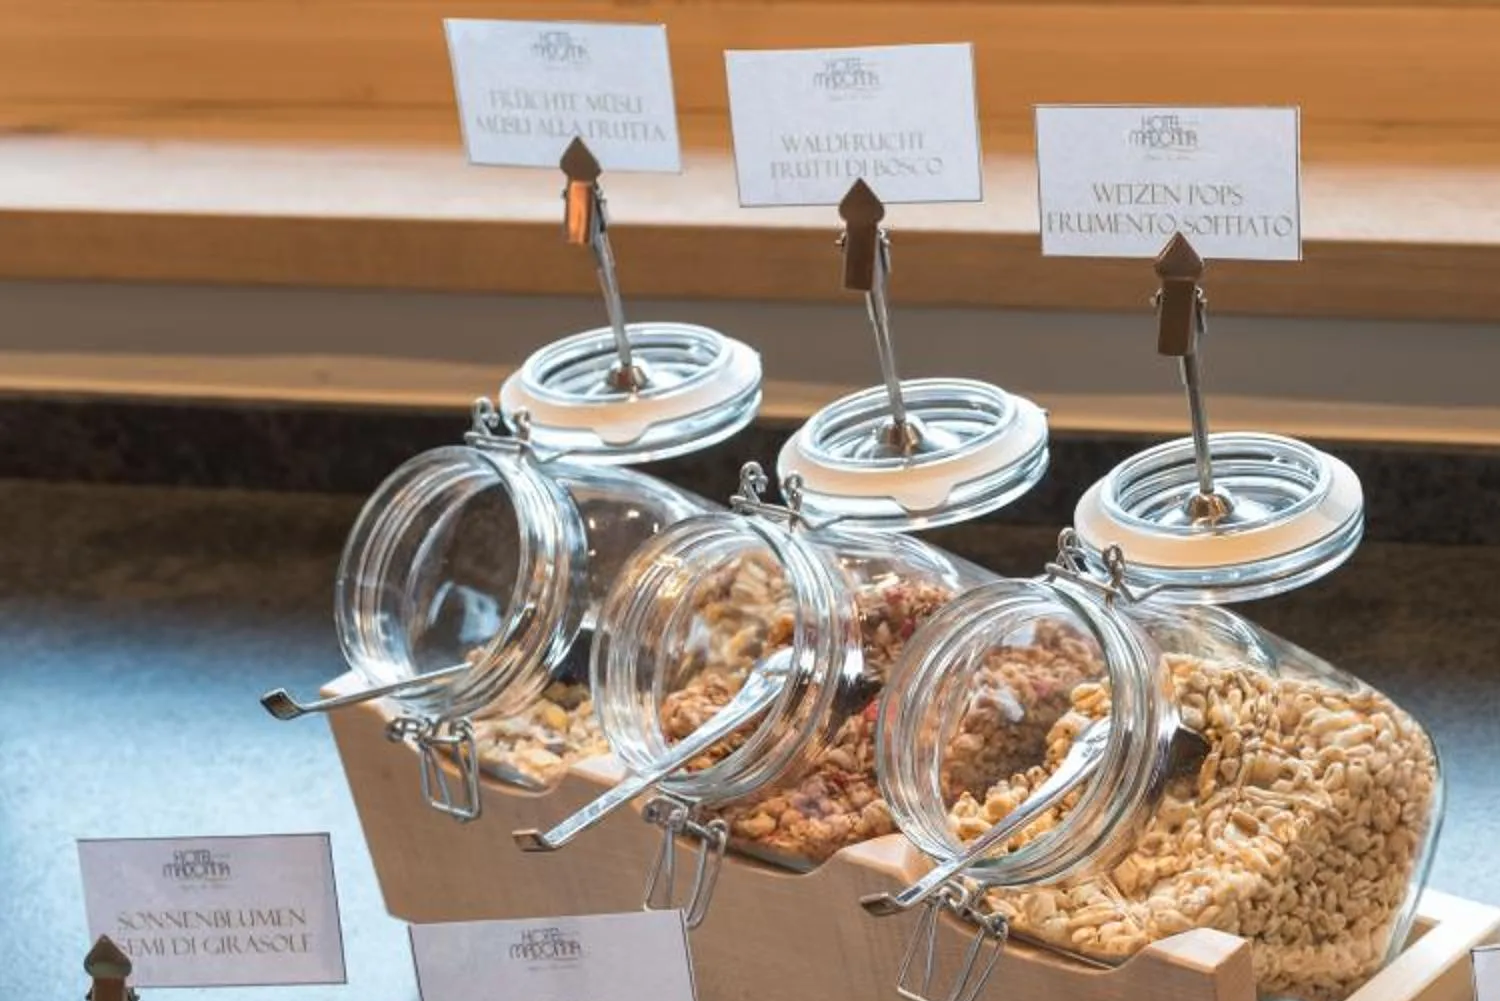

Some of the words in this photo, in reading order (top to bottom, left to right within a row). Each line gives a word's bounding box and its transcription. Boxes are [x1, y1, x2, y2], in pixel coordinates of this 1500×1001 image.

[588, 119, 667, 141] FRUTTA
[770, 159, 840, 179] FRUTTI
[845, 159, 868, 177] DI
[873, 157, 944, 177] BOSCO
[1092, 183, 1182, 206] WEIZEN
[1189, 184, 1244, 207] POPS
[1047, 212, 1177, 235] FRUMENTO
[1182, 213, 1294, 238] SOFFIATO
[117, 908, 307, 931] SONNENBLUMEN
[171, 936, 197, 956] DI
[202, 933, 314, 955] GIRASOLE
